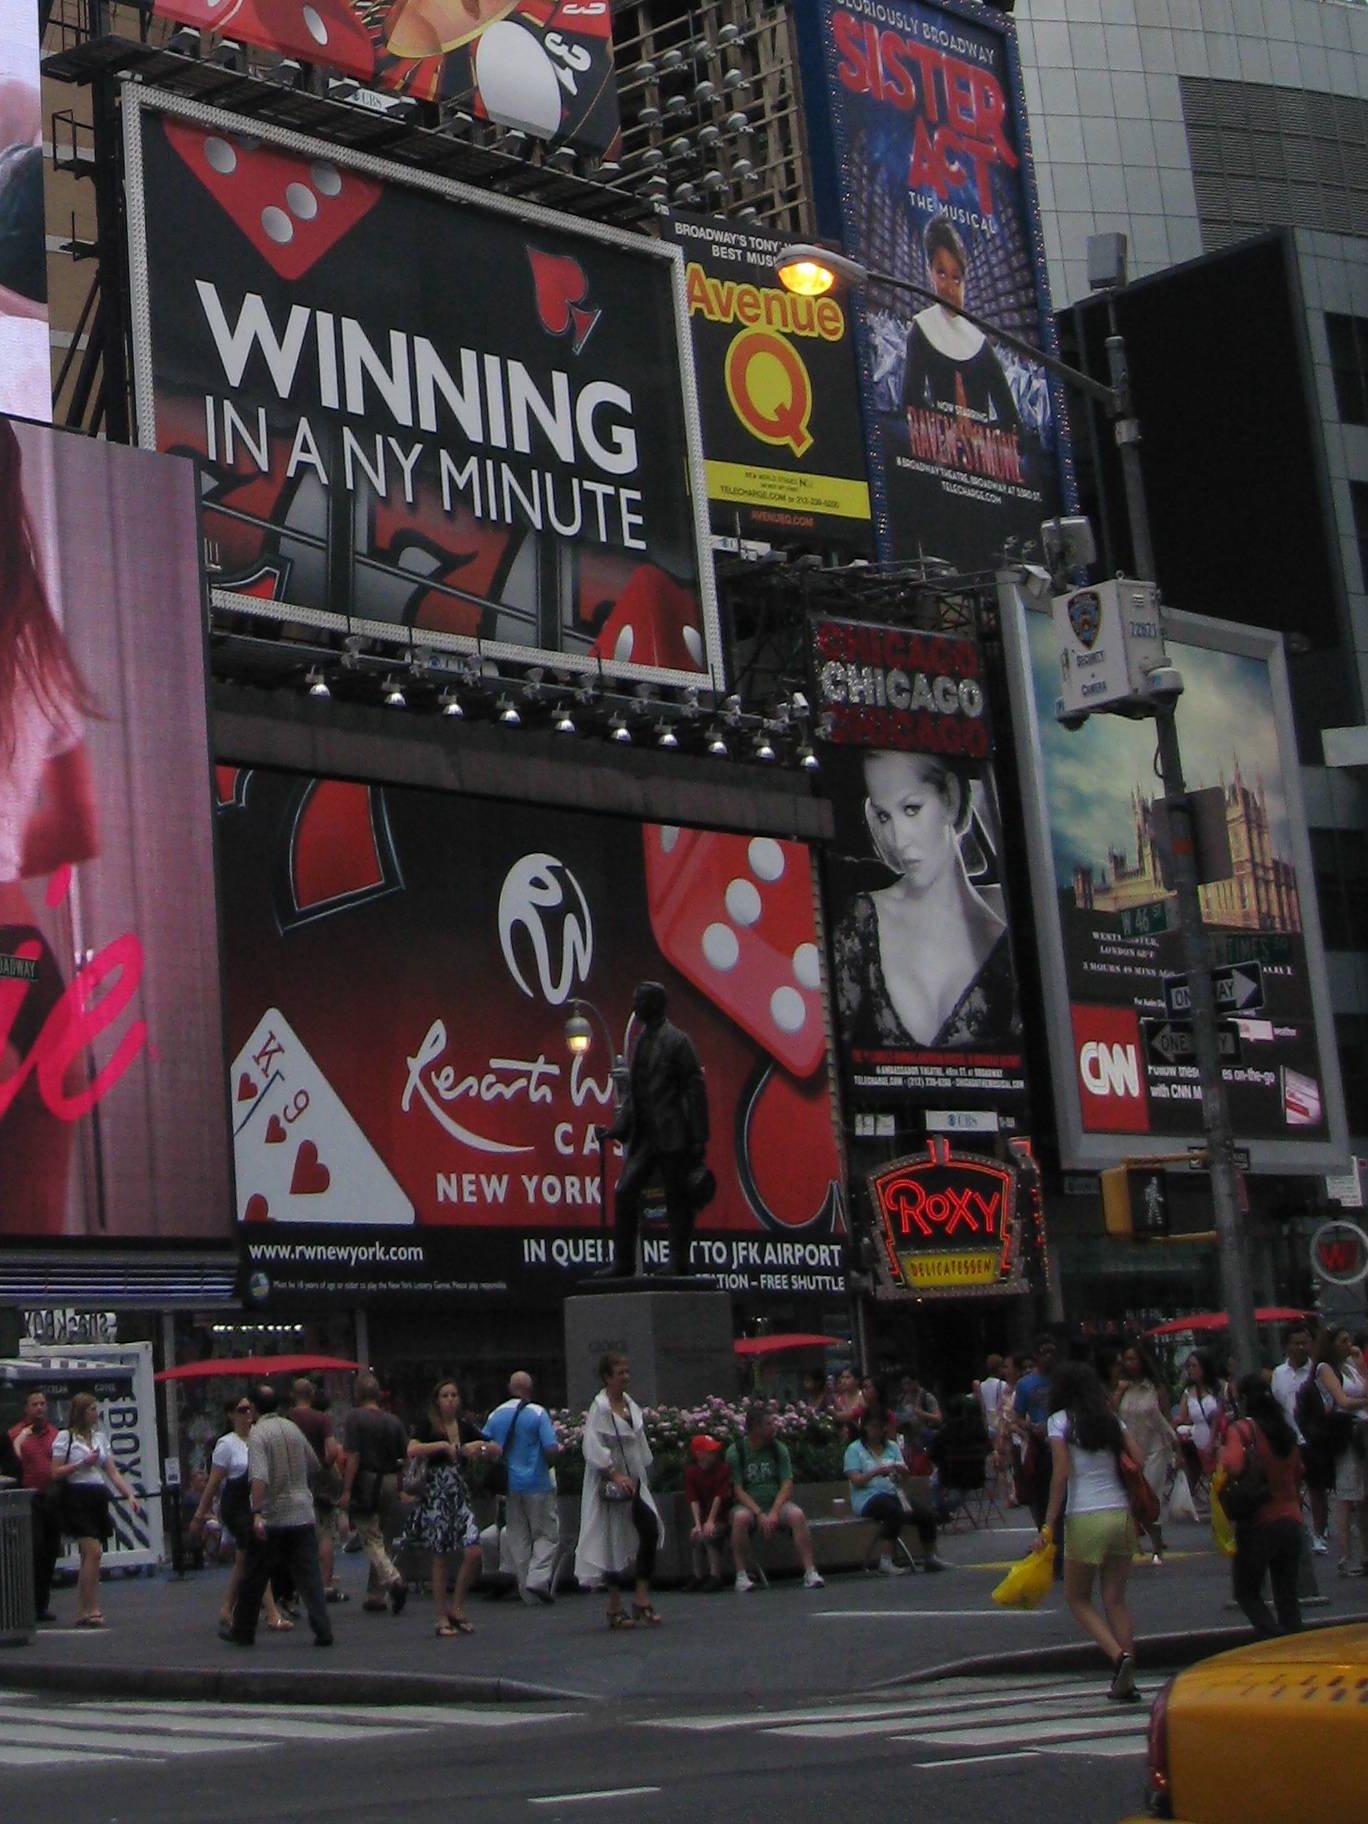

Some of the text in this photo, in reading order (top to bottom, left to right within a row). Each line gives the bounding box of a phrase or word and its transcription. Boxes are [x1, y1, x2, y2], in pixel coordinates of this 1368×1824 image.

[922, 23, 995, 65] BROADWAY
[833, 9, 1019, 168] SISTER
[908, 114, 998, 215] ACT
[908, 191, 997, 235] THE MUSICAL
[674, 221, 748, 248] BROADWAY'S
[711, 245, 778, 268] BEST MUSI
[686, 262, 845, 342] Avenue
[194, 279, 640, 475] WINNING
[724, 327, 814, 459] Q
[204, 394, 270, 474] IN
[439, 448, 647, 551] MINUTE
[817, 621, 978, 676] CHICAGO
[821, 660, 984, 718] CHICAGO
[826, 703, 989, 759] CHICAGO
[1135, 907, 1150, 932] 46
[1090, 962, 1121, 974] HOURS
[1100, 945, 1136, 958] LONDON
[1175, 985, 1191, 1009] ON
[252, 1029, 285, 1078] K
[1079, 1040, 1141, 1098] CNN
[1149, 1084, 1170, 1099] with
[1171, 1085, 1192, 1100] CNN
[553, 1122, 625, 1158] CAS
[436, 1171, 509, 1205] NEW
[521, 1173, 602, 1205] YORK
[248, 1241, 423, 1265] www.rwnewyork.com
[523, 1239, 842, 1269] IN QUE NET TO JFK AIRPORT
[909, 1258, 992, 1278] DELICATESSEN
[1319, 1240, 1360, 1272] W
[760, 1275, 789, 1290] FREE
[791, 1275, 845, 1292] SHUTTLE
